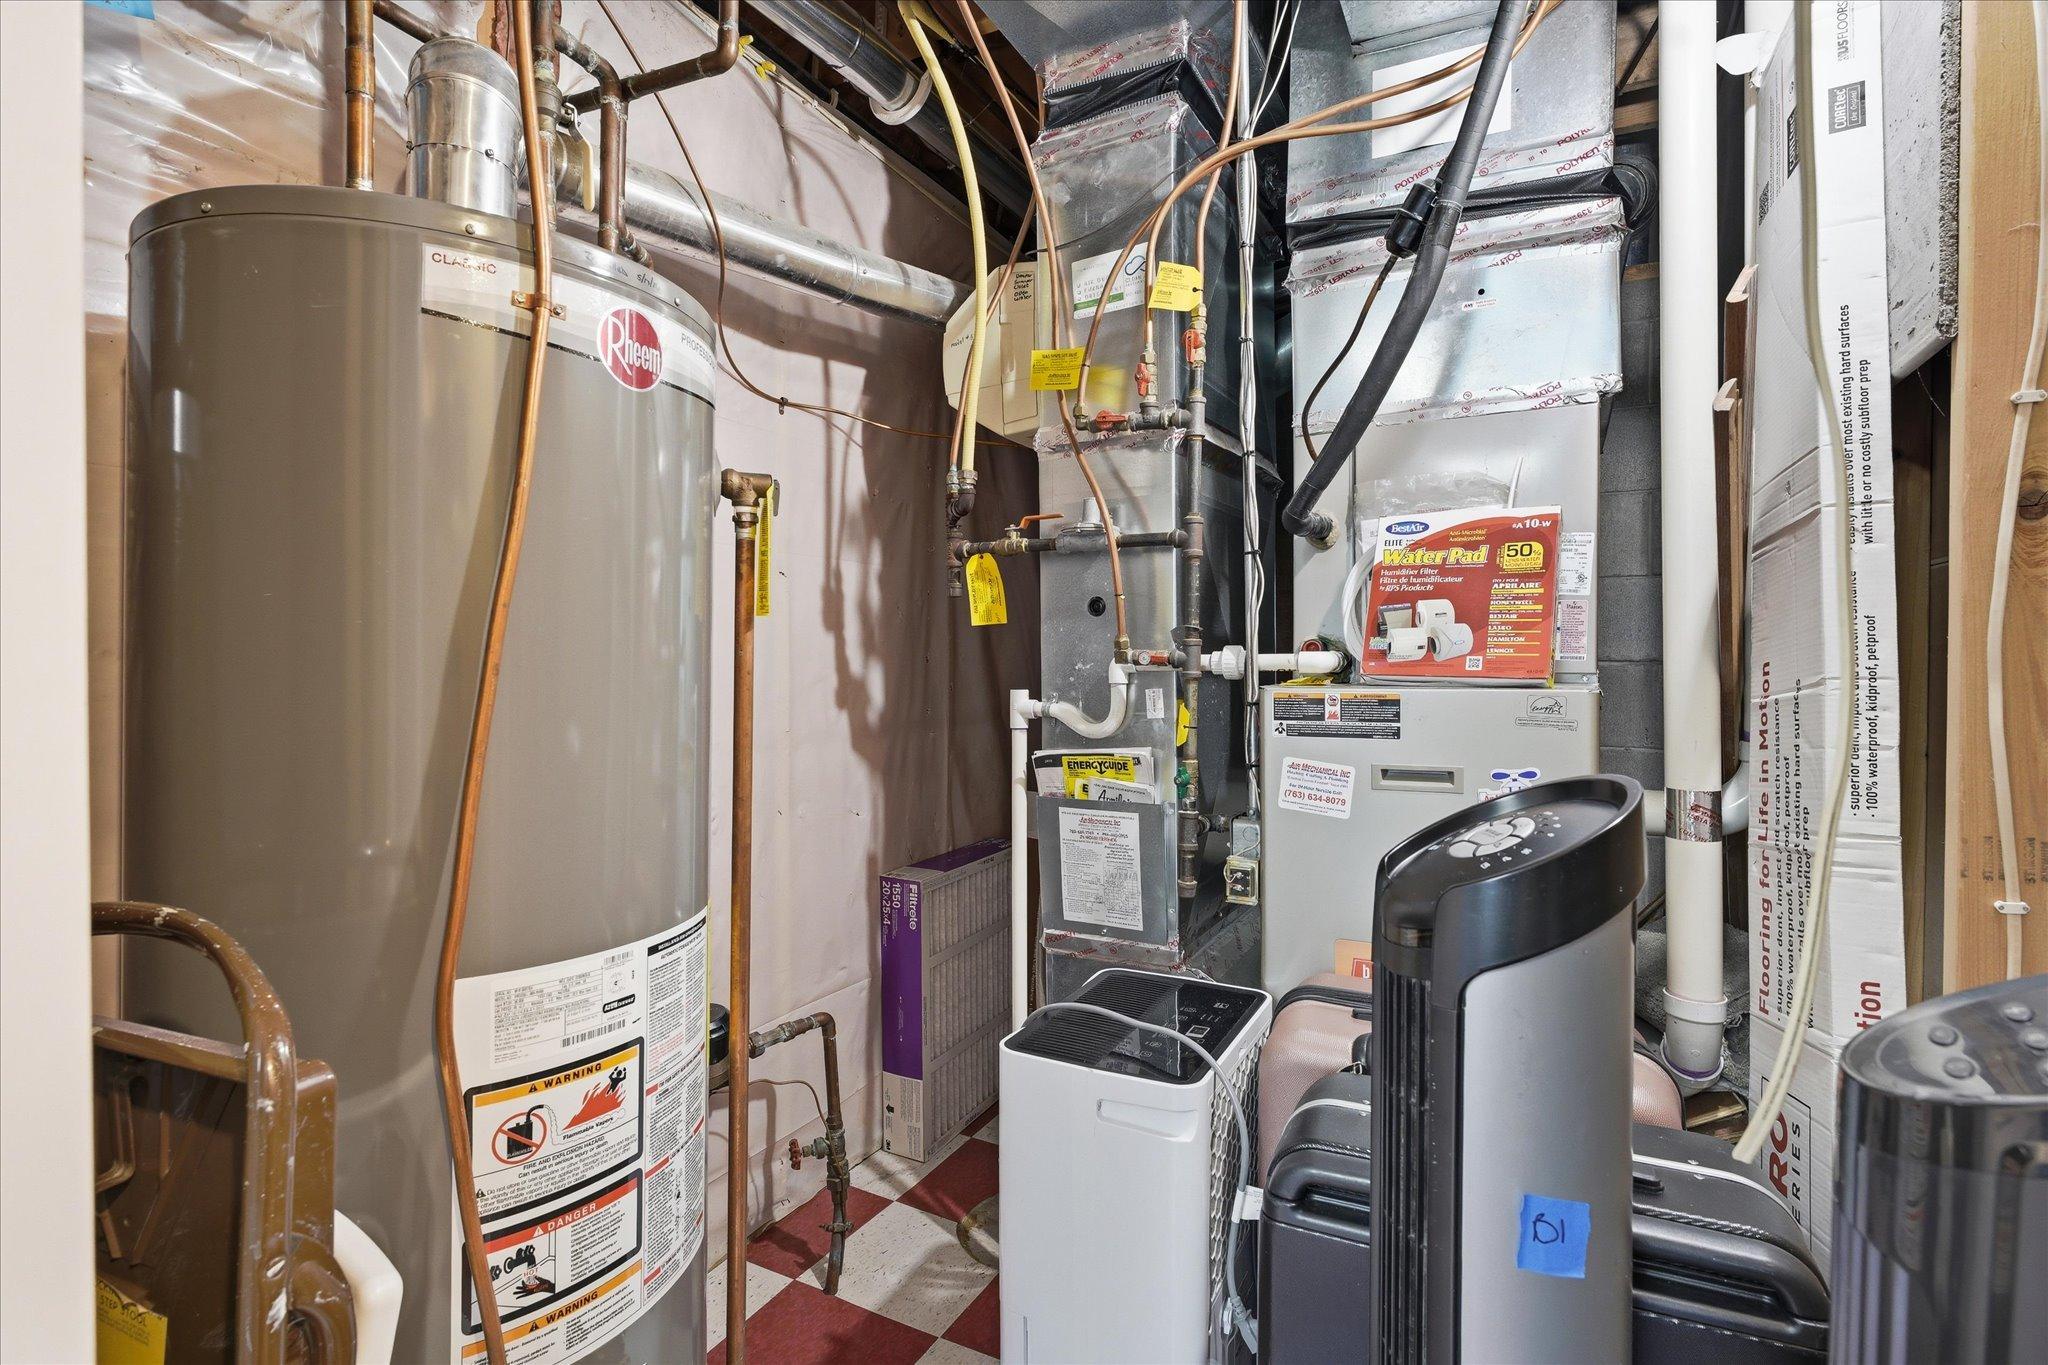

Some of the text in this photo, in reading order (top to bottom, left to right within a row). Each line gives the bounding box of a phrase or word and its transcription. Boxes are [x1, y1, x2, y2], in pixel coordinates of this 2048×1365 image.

[1838, 304, 1850, 348] surfaces
[604, 309, 661, 377] Rheem
[1840, 350, 1851, 374] hard
[1858, 359, 1871, 383] prep
[1841, 376, 1854, 415] existing
[1858, 386, 1870, 428] subfloor
[1843, 418, 1853, 445] most
[1860, 432, 1874, 461] costly
[1861, 465, 1871, 477] no
[1862, 480, 1872, 491] or
[1391, 524, 1425, 533] BestAir
[1861, 522, 1874, 545] with
[1382, 547, 1448, 566] Water
[1446, 544, 1490, 565] Pad
[1400, 584, 1434, 592] Products
[1864, 615, 1879, 811] 100% waterproof, kidproof, petproof
[1067, 760, 1129, 772] ENERGYGUIDE
[1793, 744, 1801, 777] hard
[1284, 789, 1306, 801] (763)
[1783, 756, 1792, 818] petproof
[1849, 763, 1862, 810] superior
[1794, 782, 1803, 839] existing
[1802, 806, 1811, 841] prep
[1757, 661, 1773, 1016] Flooring for Life in Motion
[892, 882, 902, 909] 1550
[1775, 861, 1784, 908] impact
[1797, 883, 1805, 916] over
[1785, 889, 1795, 974] waterproof,
[1775, 953, 1784, 1014] superior
[543, 1063, 603, 1089] WARNING
[562, 1125, 595, 1141] Flammable
[523, 1135, 605, 1171] FIRE AND EXPLOSION HAZARD
[547, 1203, 597, 1231] DANGER
[546, 1290, 598, 1326] WARNING
